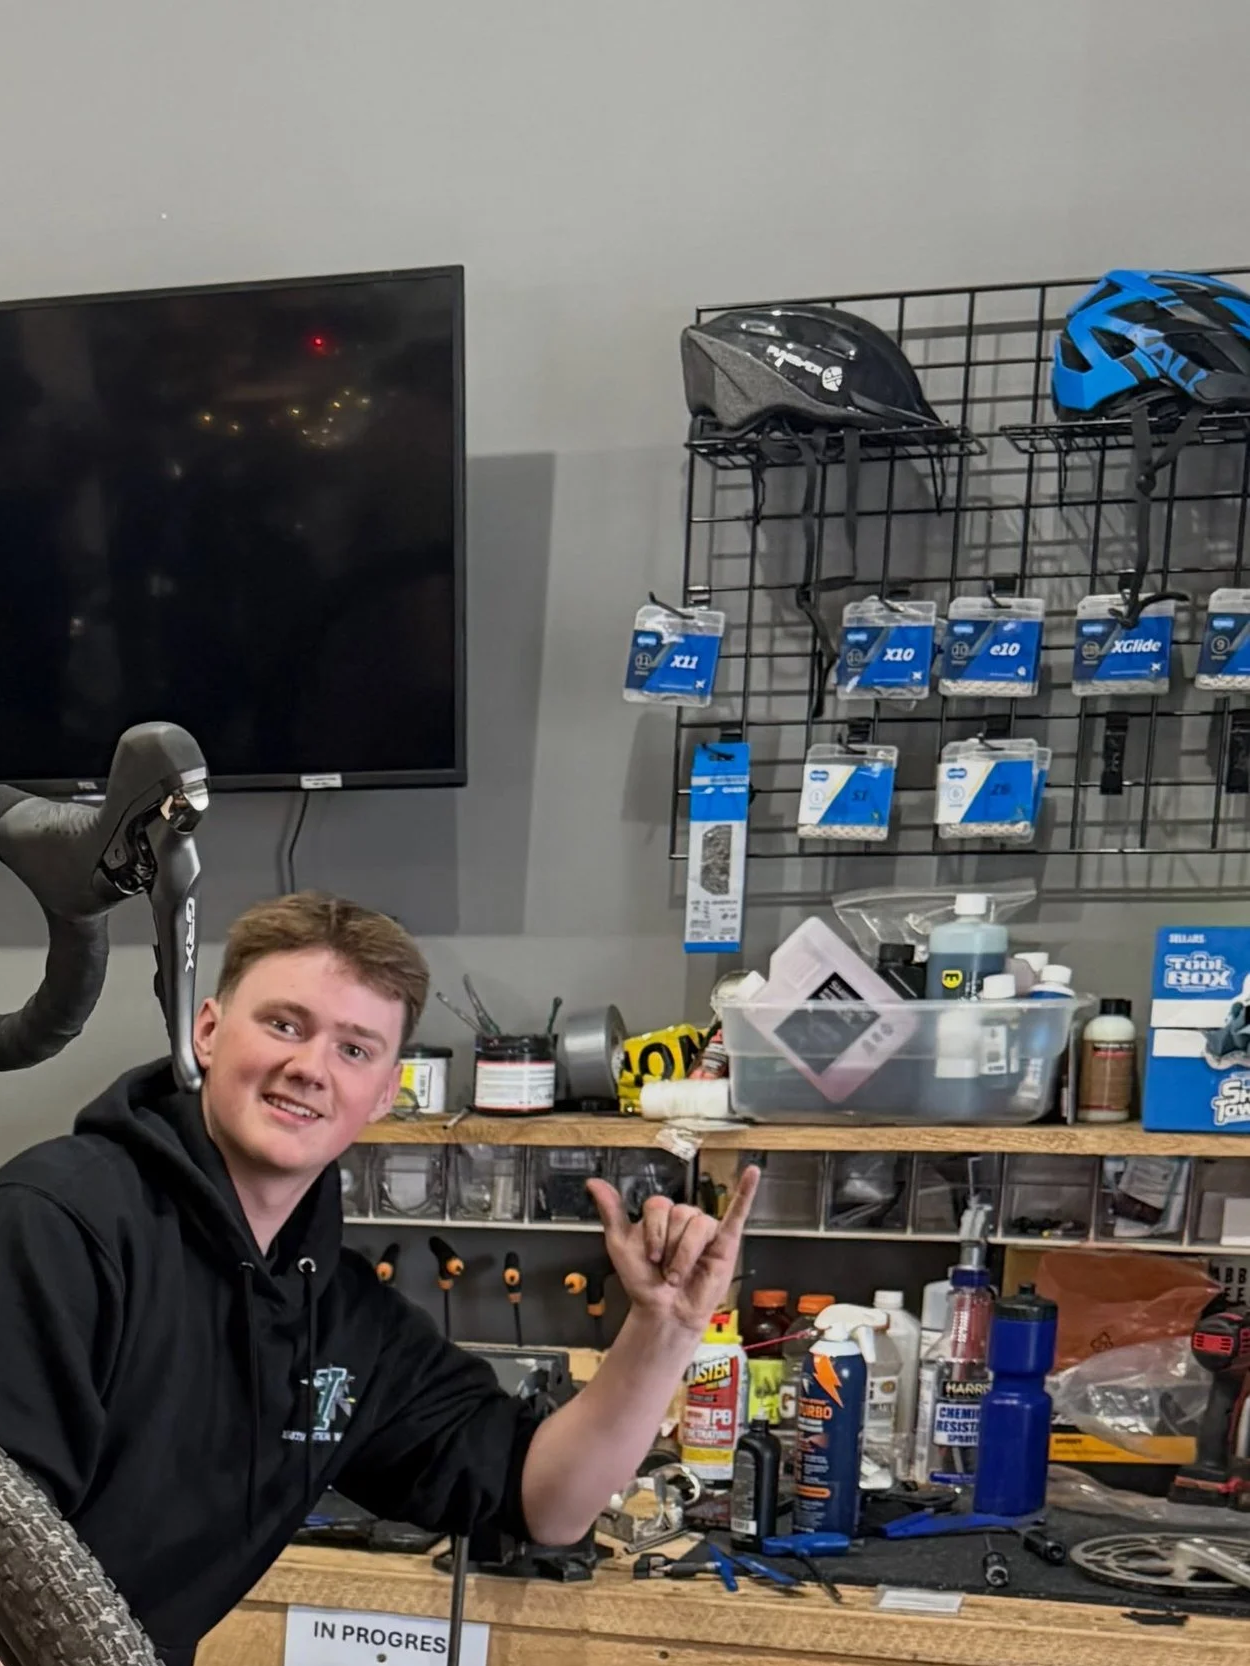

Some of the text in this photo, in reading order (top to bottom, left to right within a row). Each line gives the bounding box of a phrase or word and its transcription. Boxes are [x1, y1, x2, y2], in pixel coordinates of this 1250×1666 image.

[990, 643, 1021, 657] e10
[1111, 638, 1162, 654] XGlide
[882, 648, 915, 662] X10
[184, 896, 197, 974] GRX
[1166, 971, 1233, 987] BOX
[939, 1407, 981, 1420] CHEMI
[313, 1620, 448, 1655] IN PROGRES
